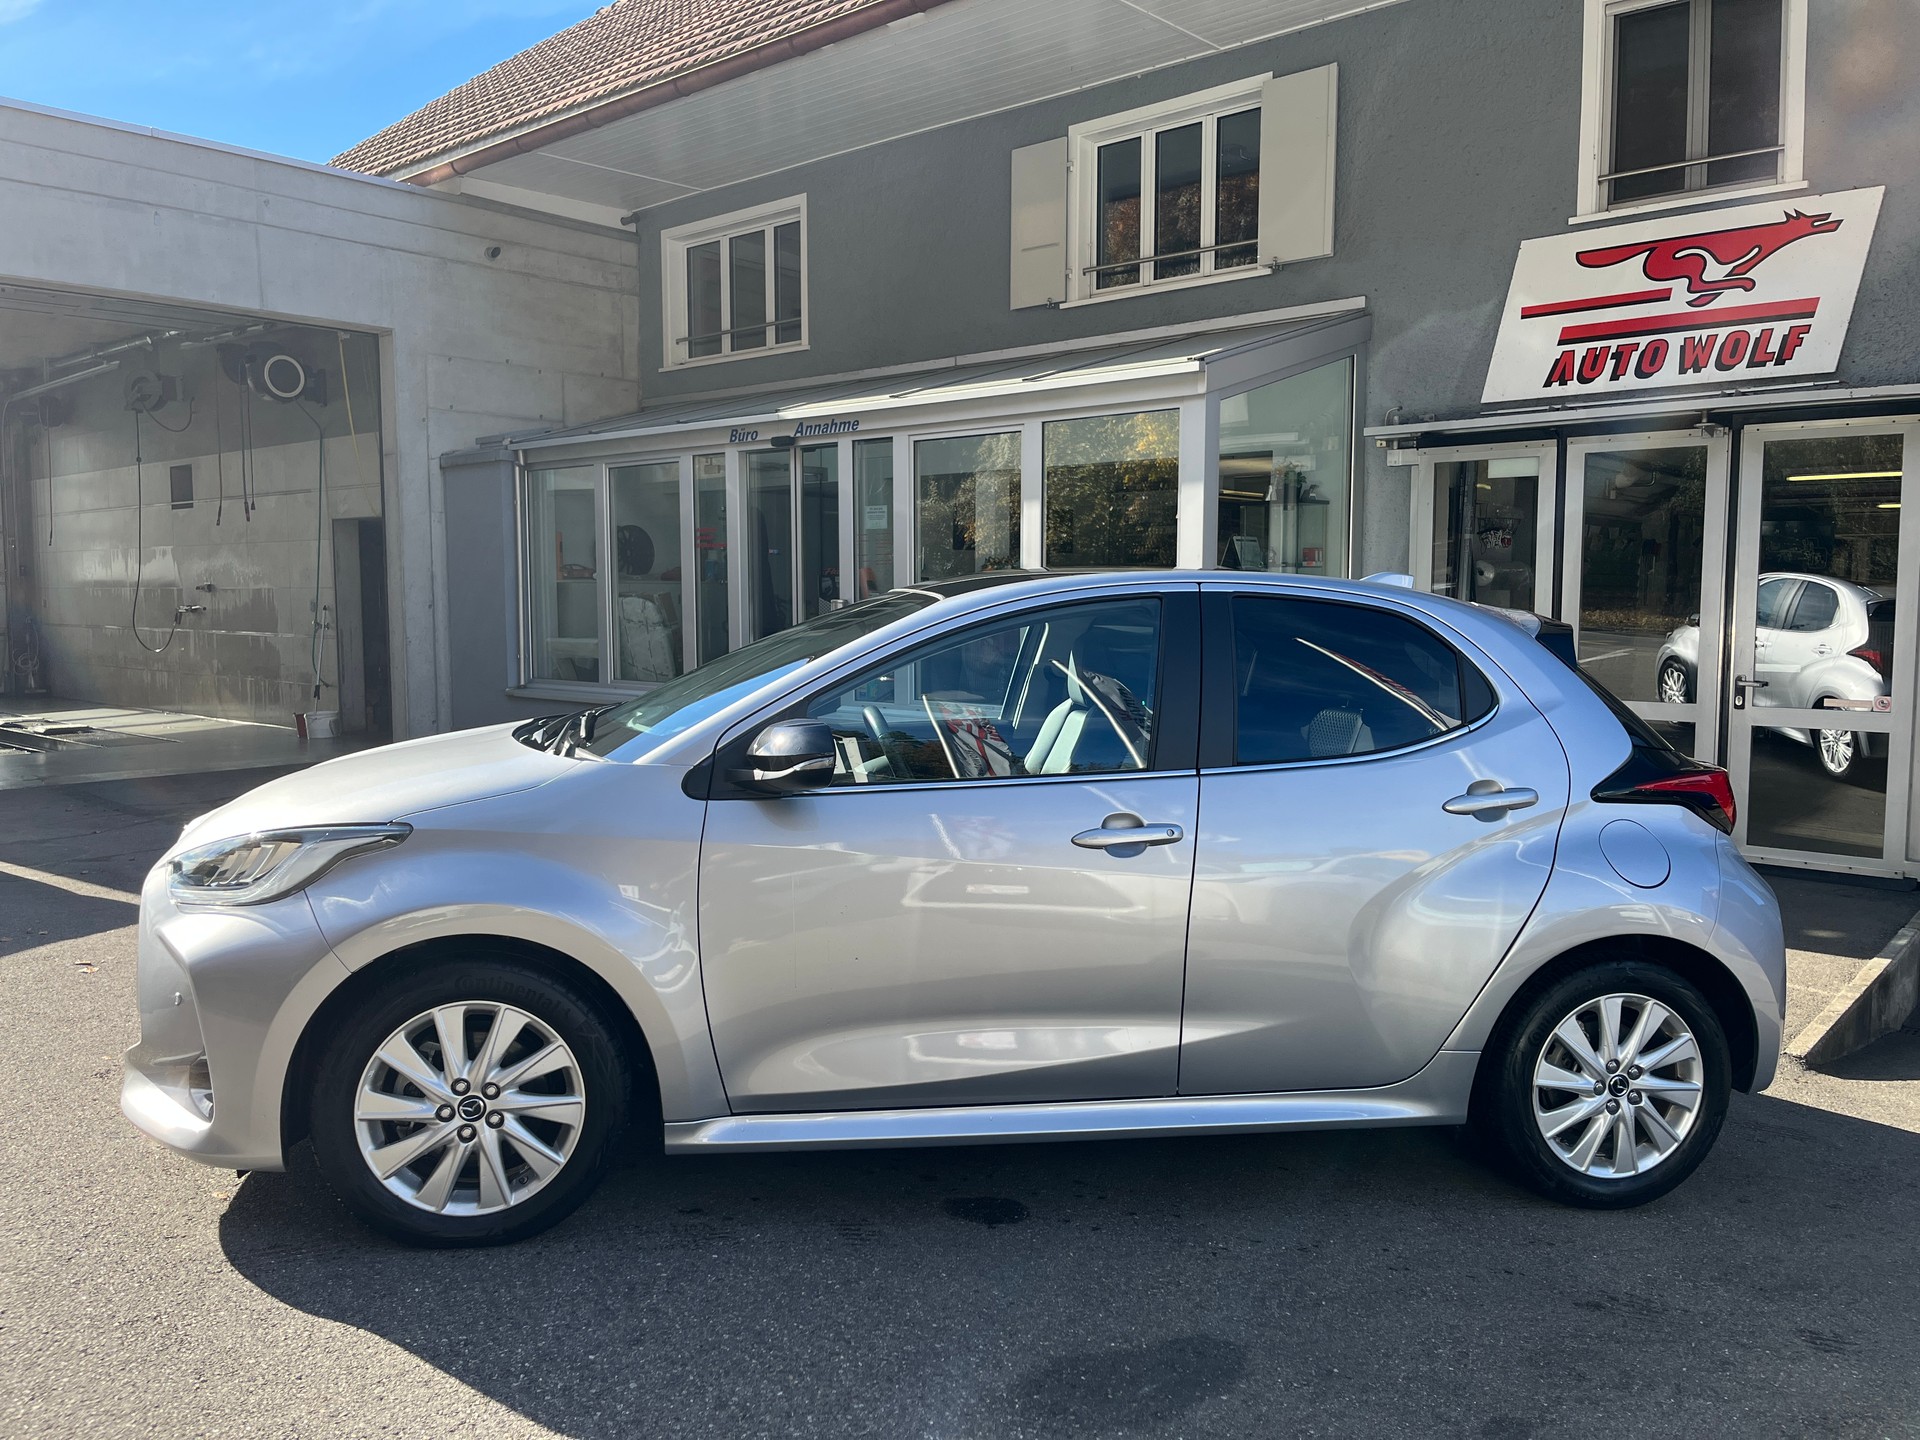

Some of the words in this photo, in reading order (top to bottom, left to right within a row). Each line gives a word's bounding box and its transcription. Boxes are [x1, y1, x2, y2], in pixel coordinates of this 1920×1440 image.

[1542, 339, 1669, 389] AUTO
[1678, 324, 1812, 375] WOLF
[729, 428, 759, 443] Büro
[794, 418, 860, 437] Annahme
[455, 974, 562, 1012] Continental
